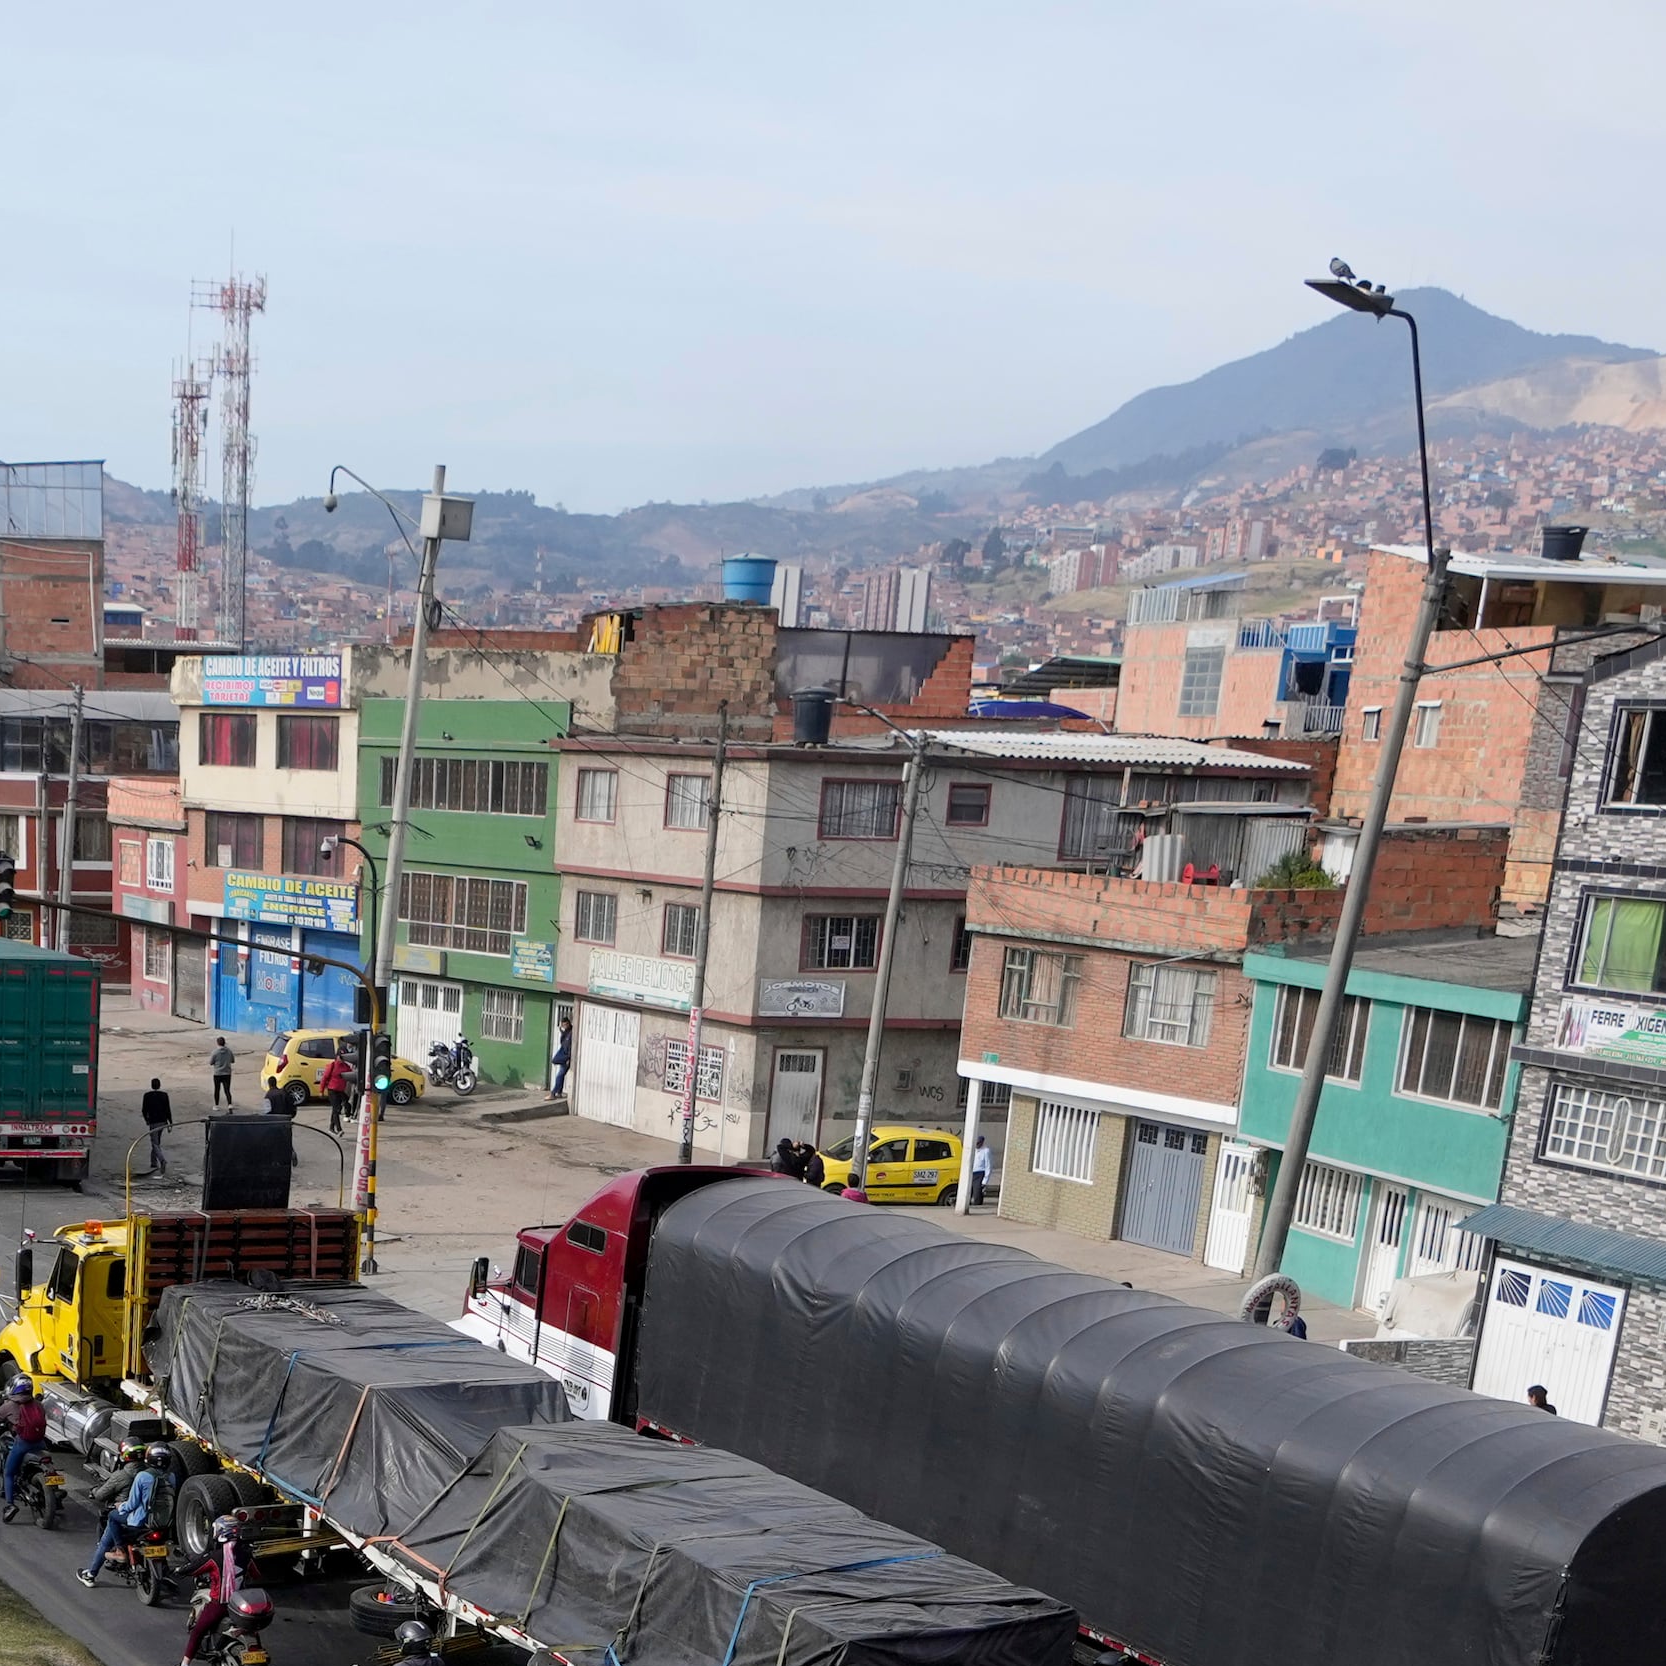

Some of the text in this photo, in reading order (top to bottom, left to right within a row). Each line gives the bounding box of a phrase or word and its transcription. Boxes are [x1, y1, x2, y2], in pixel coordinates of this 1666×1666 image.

[205, 656, 340, 678] CAMBIO DE ACEITE Y FILTROS
[205, 680, 255, 690] RECIBIMOS
[209, 691, 251, 702] TARJETAS
[227, 874, 356, 899] CAMBIO DE ACEITE
[262, 901, 326, 917] ENGRASE
[255, 934, 291, 950] ENGRASE
[258, 951, 289, 966] FILTROS
[592, 951, 694, 993] TALLER DE MOTOS
[256, 970, 287, 994] Mobil
[1591, 1010, 1626, 1028] FERRE
[683, 1056, 695, 1112] MOTOS
